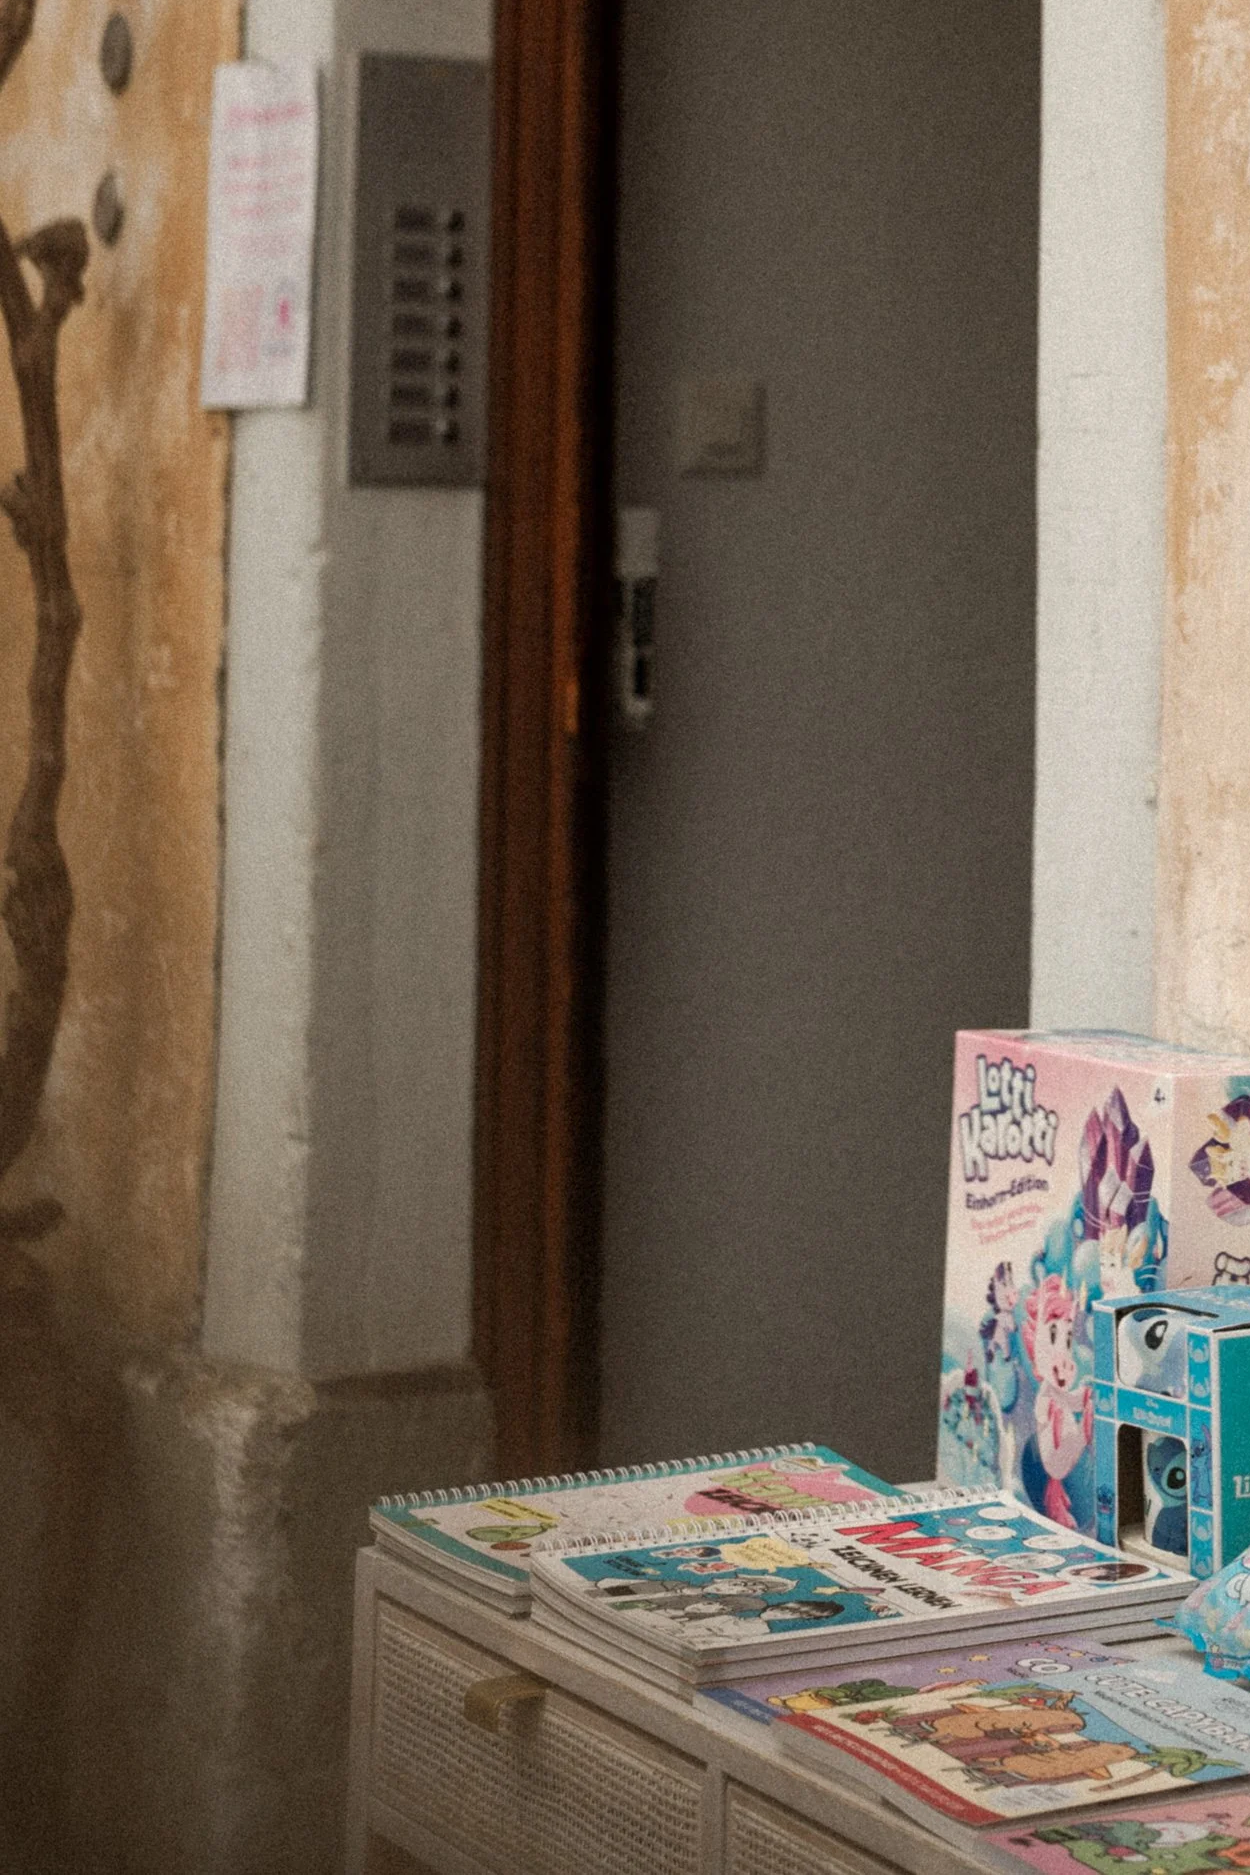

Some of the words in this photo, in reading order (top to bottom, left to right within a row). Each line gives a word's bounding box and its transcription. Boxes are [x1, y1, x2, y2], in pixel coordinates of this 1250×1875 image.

[976, 1054, 1035, 1115] Lotti
[831, 1545, 906, 1583] ZEICHNEN
[834, 1520, 1071, 1596] MANGA
